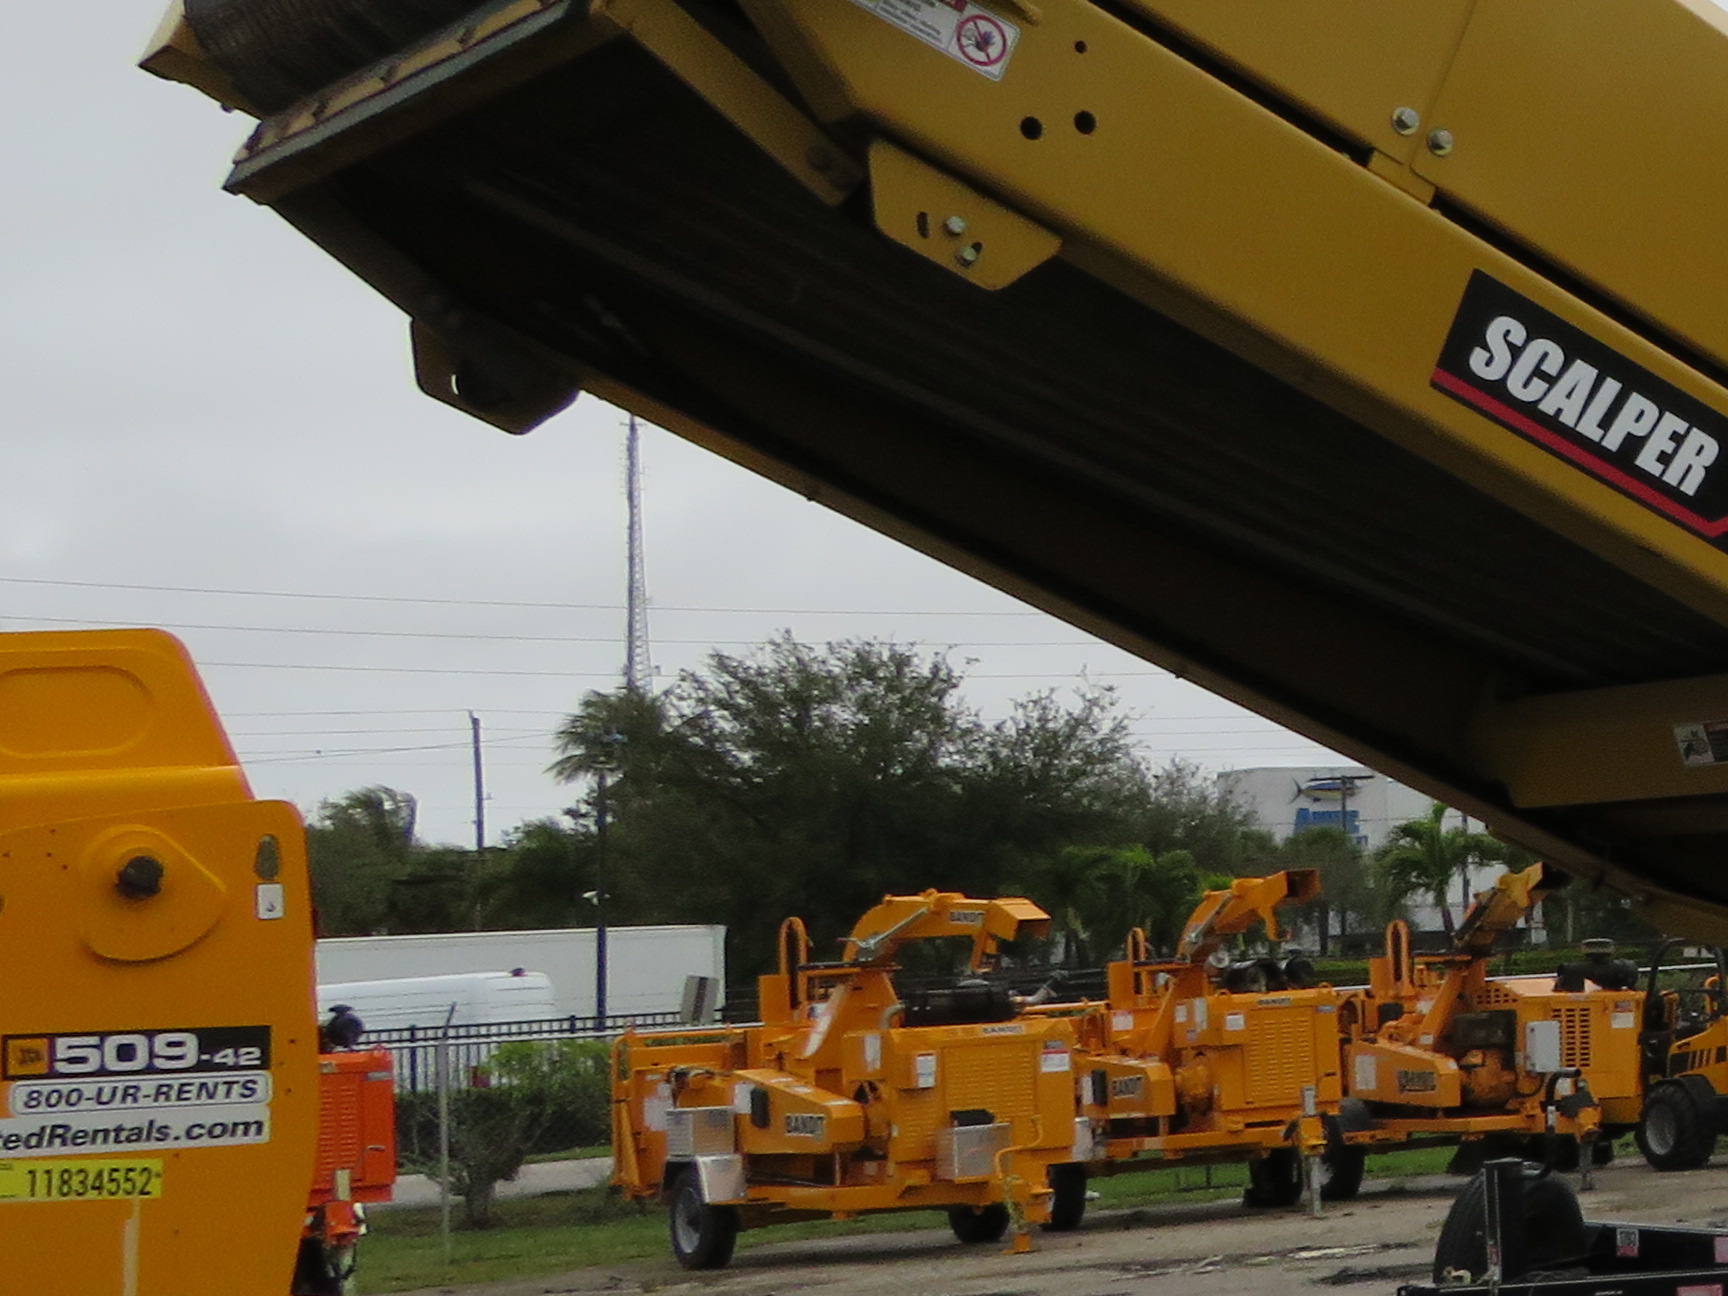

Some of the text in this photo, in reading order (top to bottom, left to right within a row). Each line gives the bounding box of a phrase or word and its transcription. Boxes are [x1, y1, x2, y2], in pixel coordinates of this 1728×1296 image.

[1469, 316, 1720, 497] SCALPER
[54, 1032, 262, 1074] 509-42
[23, 1079, 259, 1110] 800-UR-RENTS
[27, 1166, 153, 1198] 11834552
